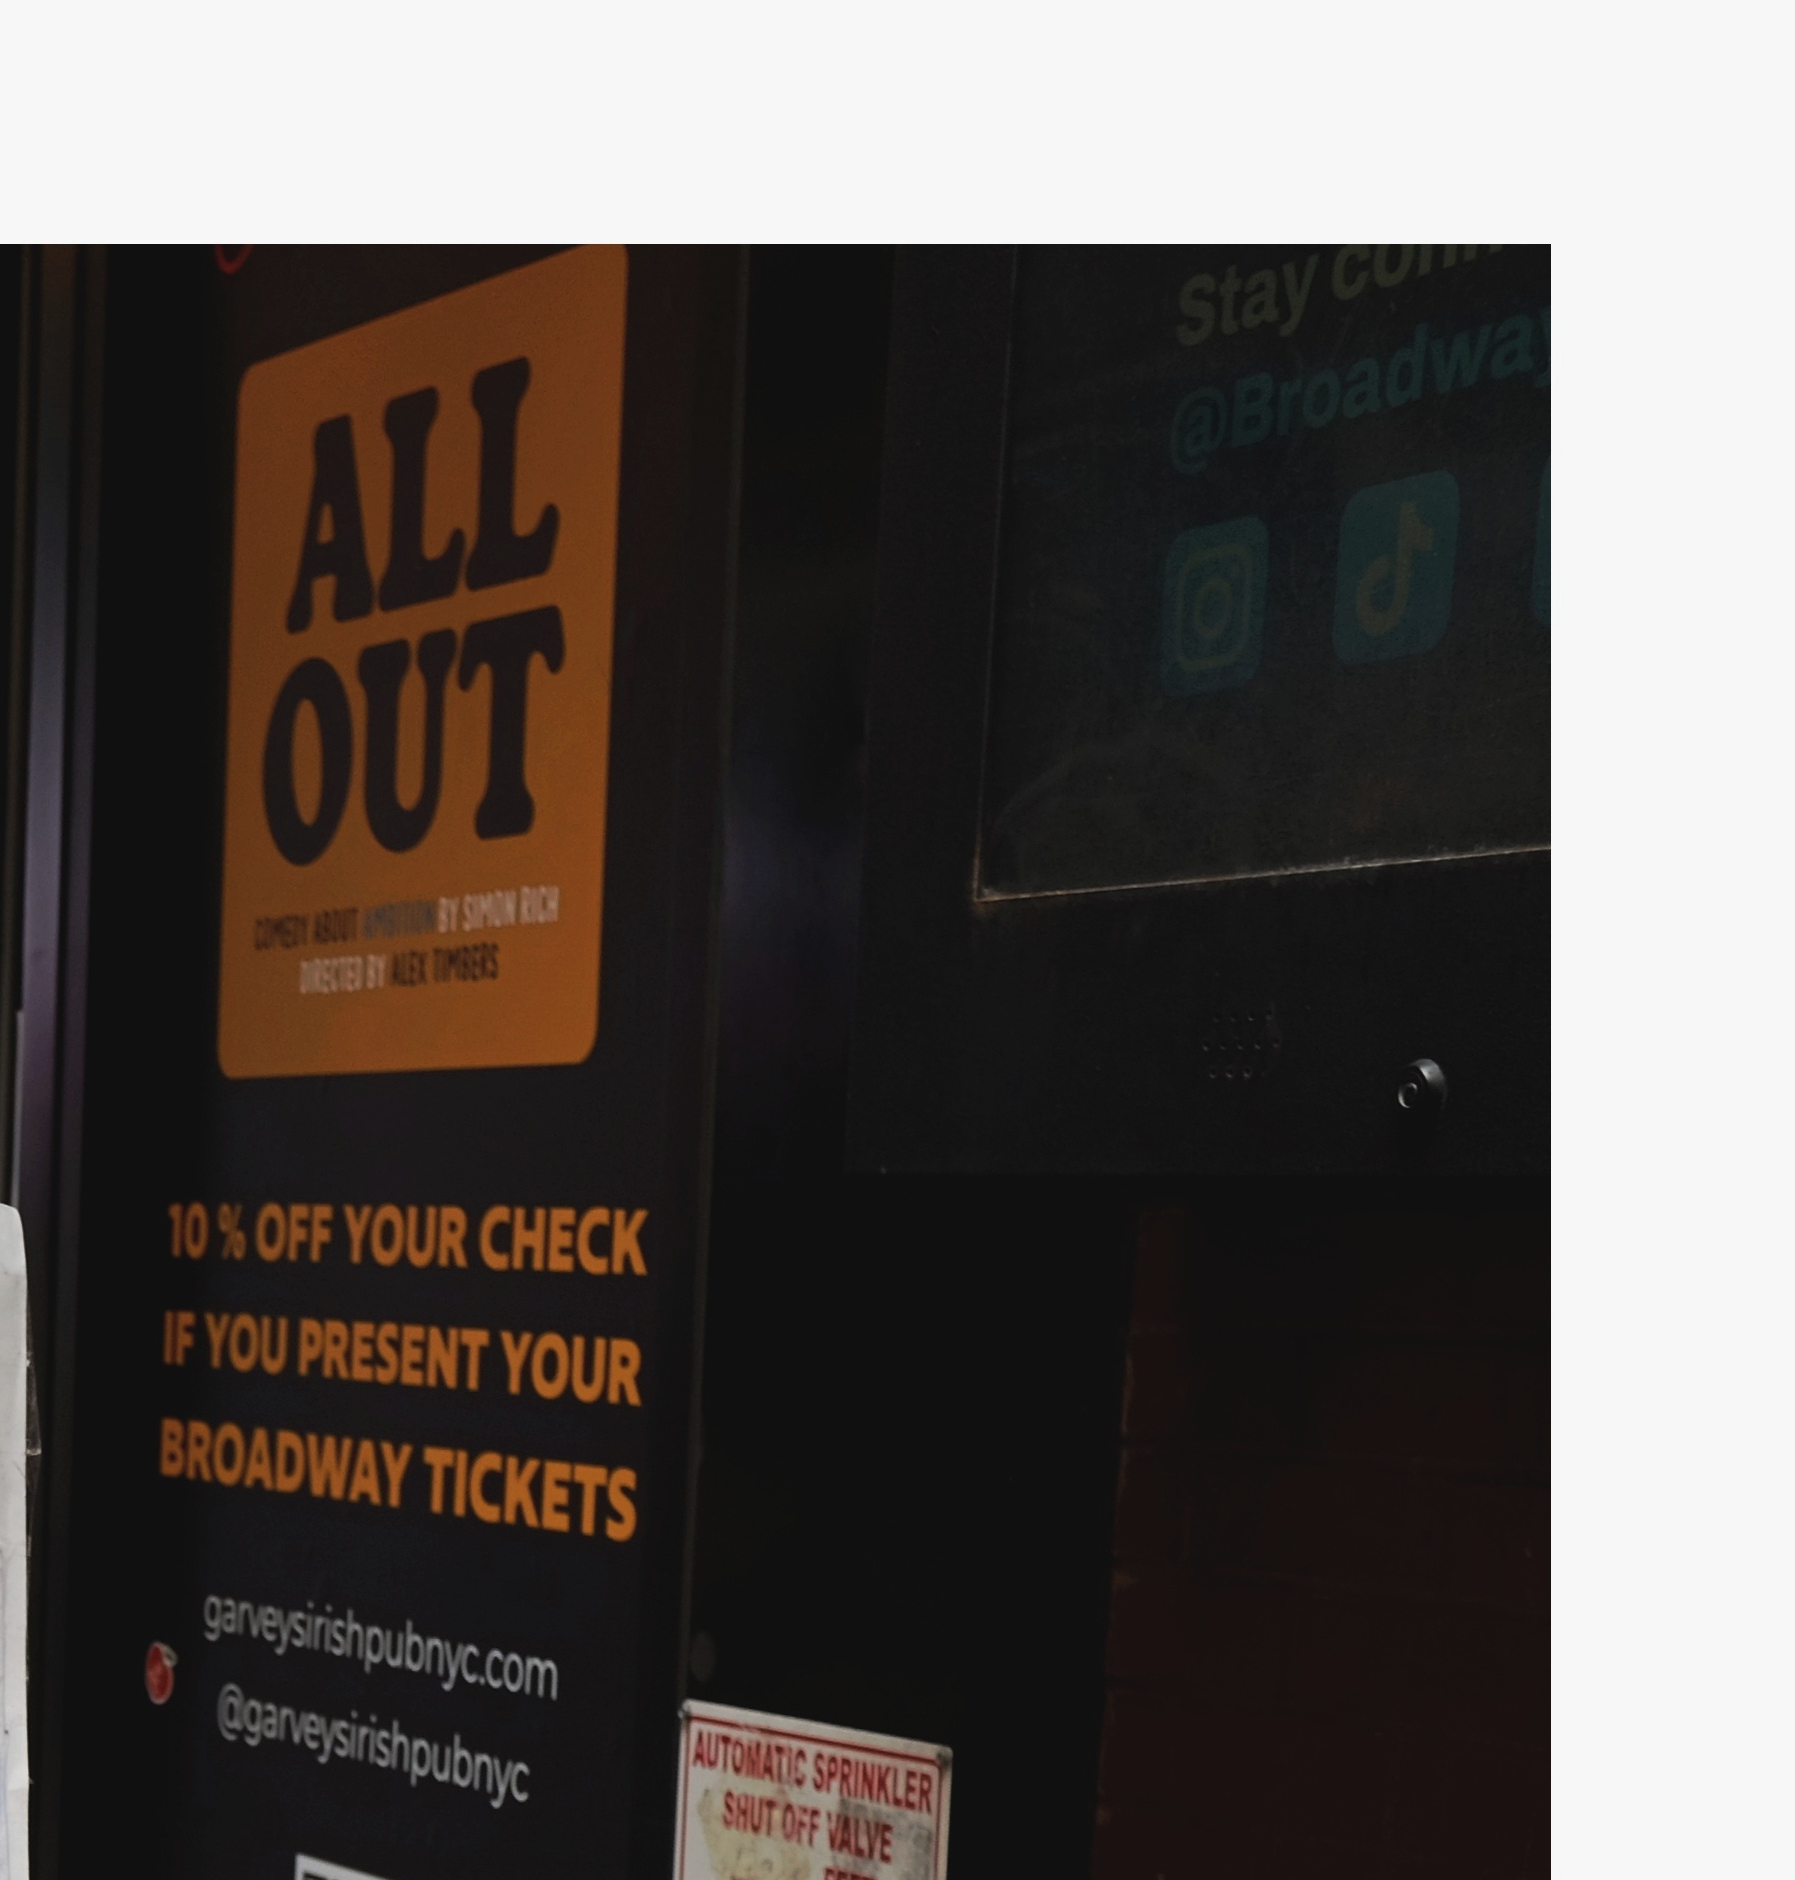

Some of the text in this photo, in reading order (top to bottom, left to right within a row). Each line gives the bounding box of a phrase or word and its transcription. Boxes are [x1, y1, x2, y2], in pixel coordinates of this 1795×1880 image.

[1176, 254, 1320, 348] Stay
[287, 356, 560, 635] ALL
[263, 605, 565, 867] OUT
[437, 889, 517, 934] BY SIMON
[366, 942, 500, 990] BY ALEX TIMBERS
[168, 1202, 648, 1276] 10 % OFF YOUR CHECK
[164, 1311, 642, 1407] IF YOU PRESENT YOUR
[159, 1417, 637, 1543] BROADWAY TICKETS
[204, 1595, 558, 1699] garveysirishpubnyc.com
[218, 1683, 530, 1808] @garveysirishpubnyc
[692, 1729, 934, 1814] AUTOMATIC SPRINKLER
[723, 1791, 894, 1864] SHUT OFF VALVE
